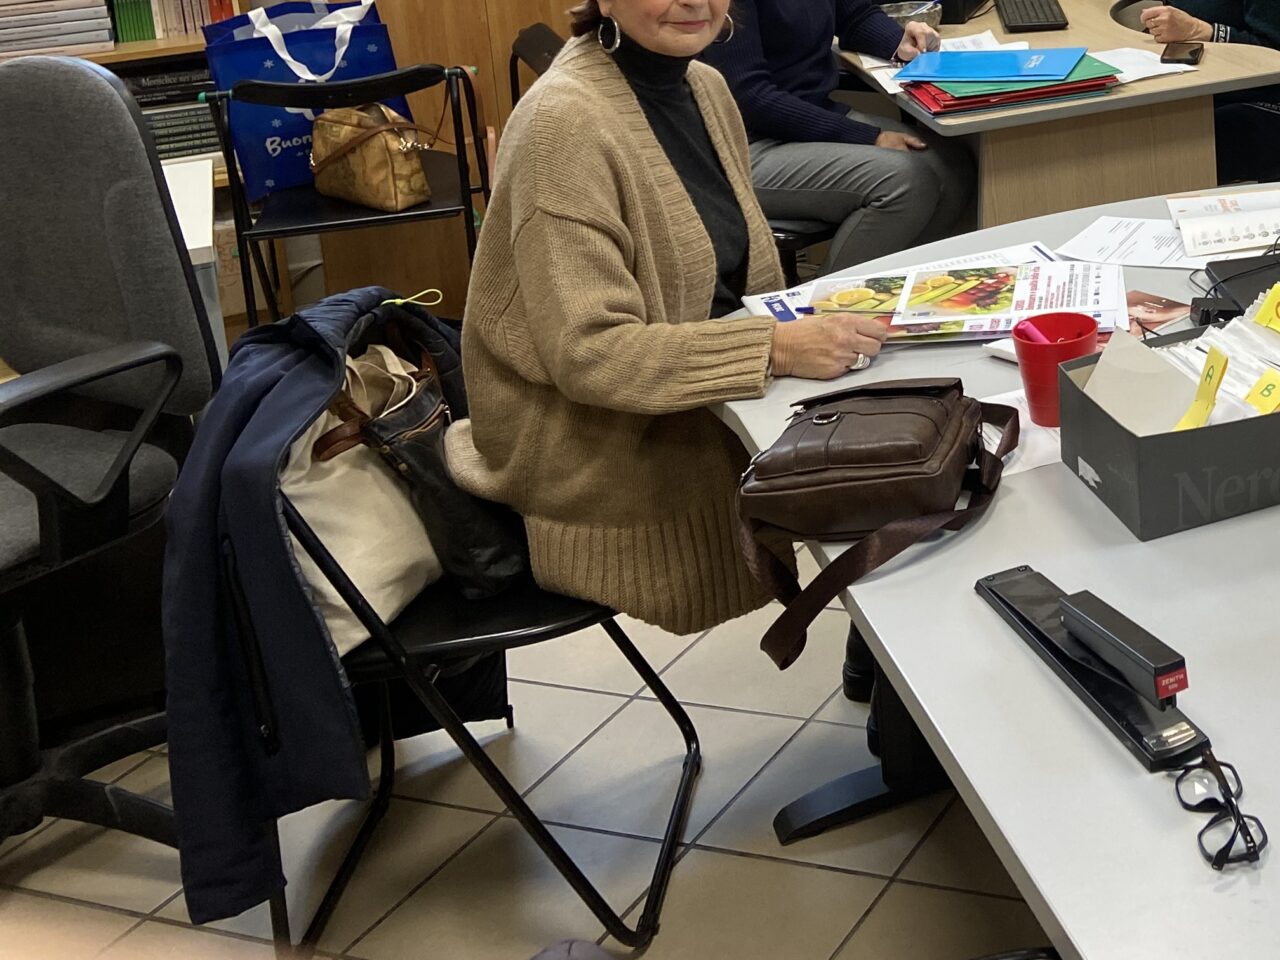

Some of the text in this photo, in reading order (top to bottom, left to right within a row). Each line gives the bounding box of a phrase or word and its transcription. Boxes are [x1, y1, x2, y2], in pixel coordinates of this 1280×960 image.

[265, 135, 312, 157] Buon
[1204, 365, 1214, 385] A
[1260, 383, 1276, 398] B
[1162, 674, 1184, 686] ZENITH
